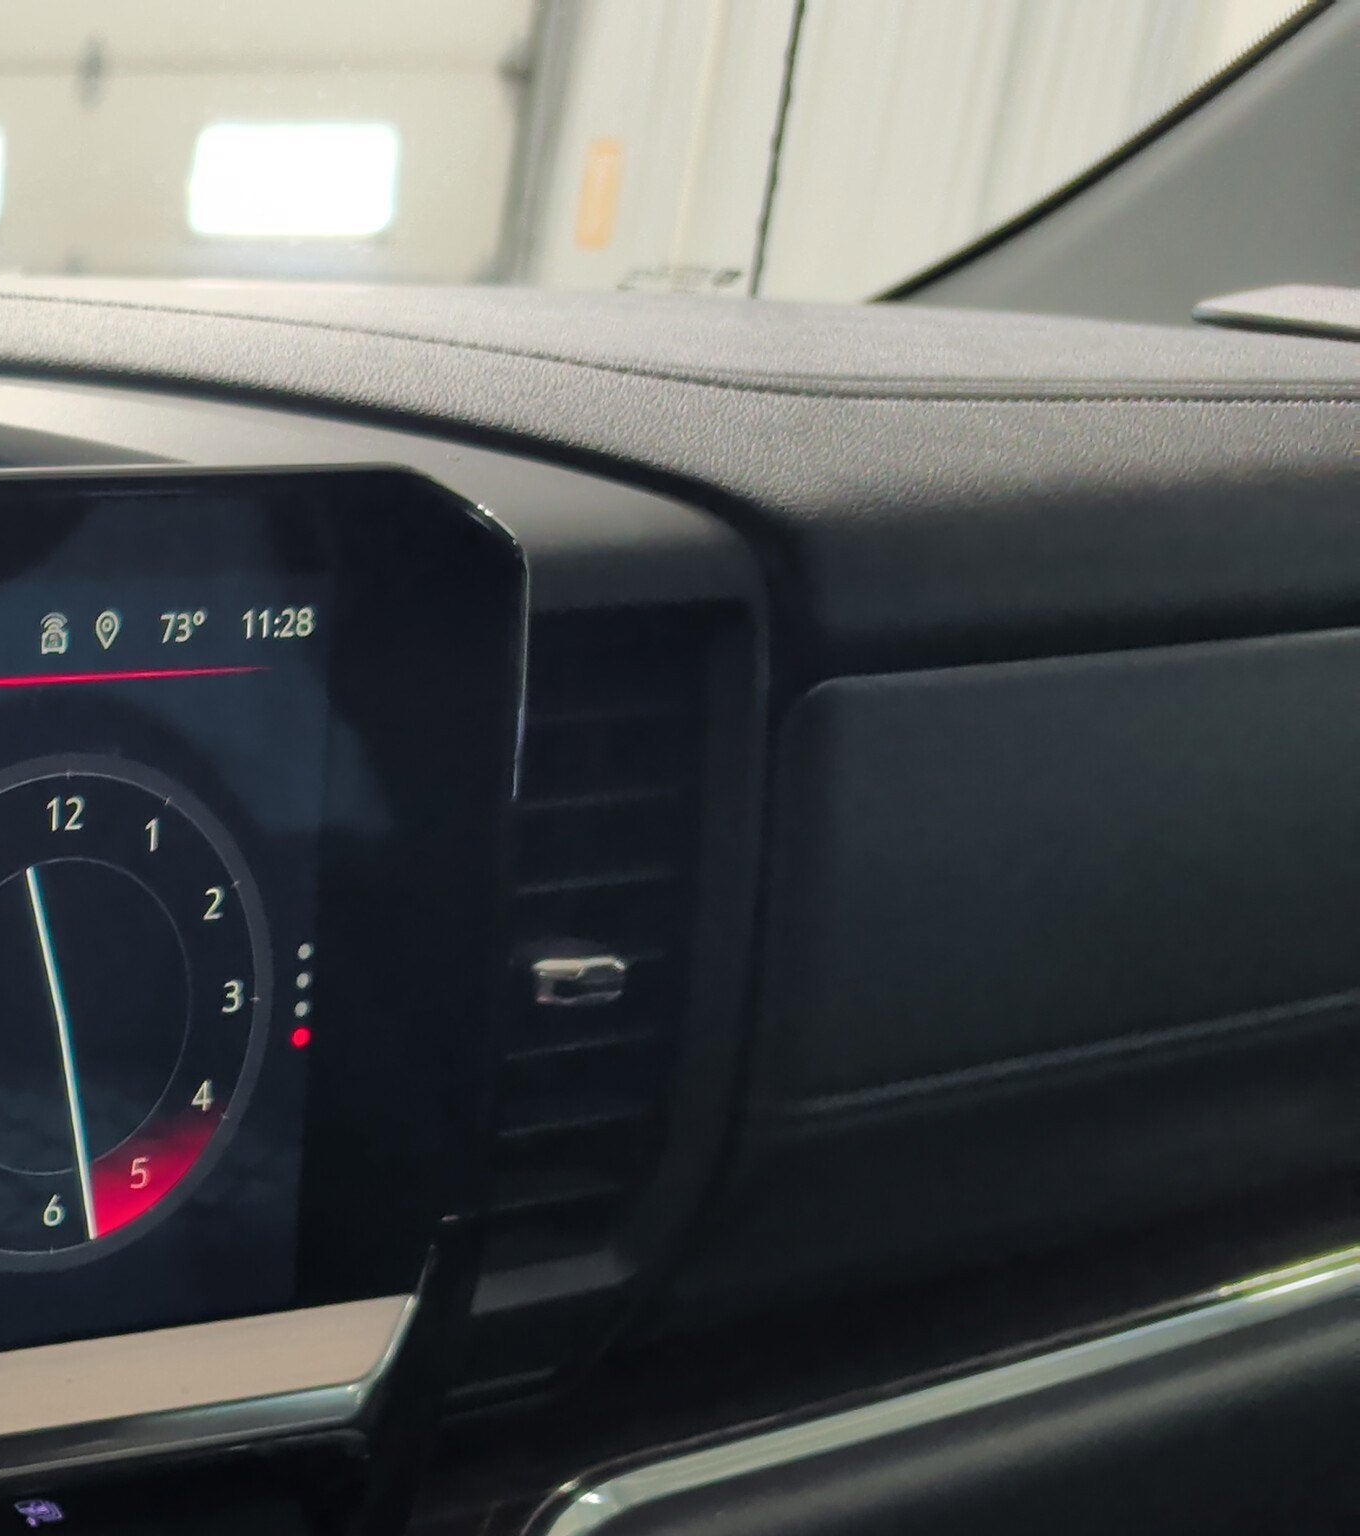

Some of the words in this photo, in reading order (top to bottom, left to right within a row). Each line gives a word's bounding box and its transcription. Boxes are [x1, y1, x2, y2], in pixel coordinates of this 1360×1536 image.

[243, 608, 313, 639] 11:28
[47, 797, 83, 831] 12
[146, 819, 160, 852] 1
[204, 888, 222, 919] 2
[223, 981, 243, 1012] 3
[192, 1081, 211, 1111] 4
[130, 1159, 148, 1189] 5
[44, 1195, 64, 1226] 6
